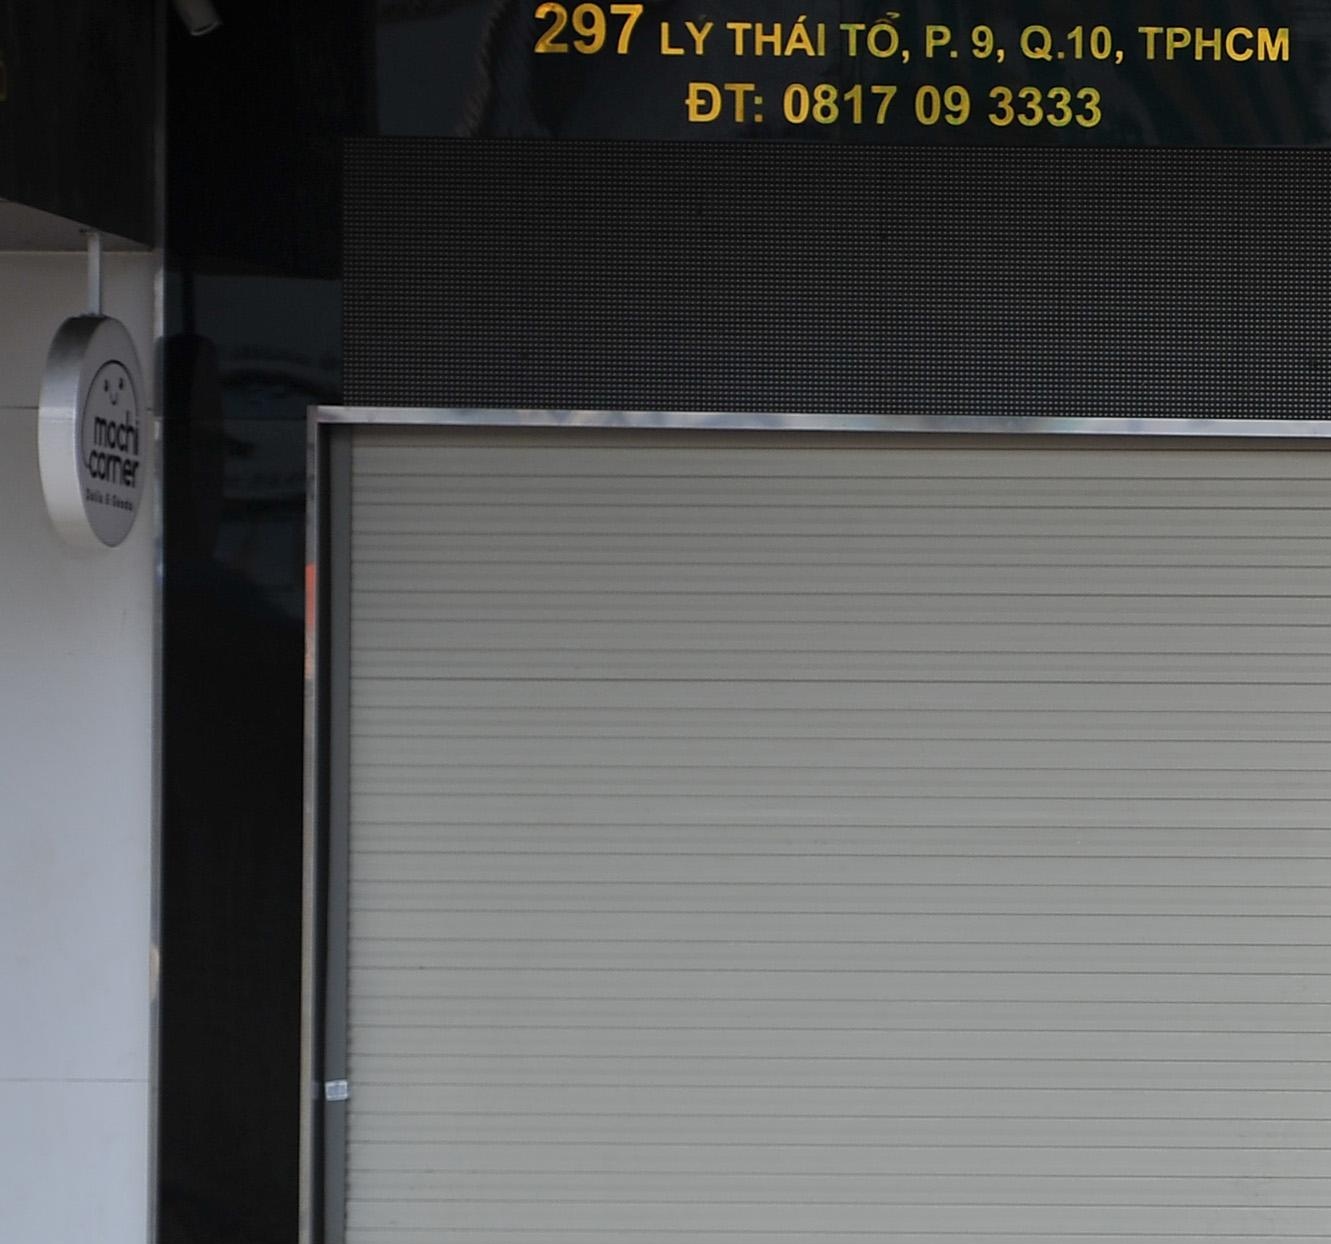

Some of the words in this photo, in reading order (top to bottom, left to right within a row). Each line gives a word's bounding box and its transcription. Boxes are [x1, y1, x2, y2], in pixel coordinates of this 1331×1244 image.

[534, 3, 643, 54] 297
[660, 19, 713, 56] LÝ
[727, 15, 826, 56] THÁI
[841, 11, 910, 63] TỔ,
[926, 25, 958, 58] P.
[972, 25, 1005, 62] 9,
[1020, 26, 1124, 65] Q.10,
[1138, 26, 1290, 61] TPHCM
[685, 83, 763, 123] ĐT:
[783, 84, 894, 124] 0817
[915, 85, 971, 125] 09
[989, 87, 1102, 127] 3333
[94, 410, 139, 455] mochi
[88, 450, 140, 487] corner
